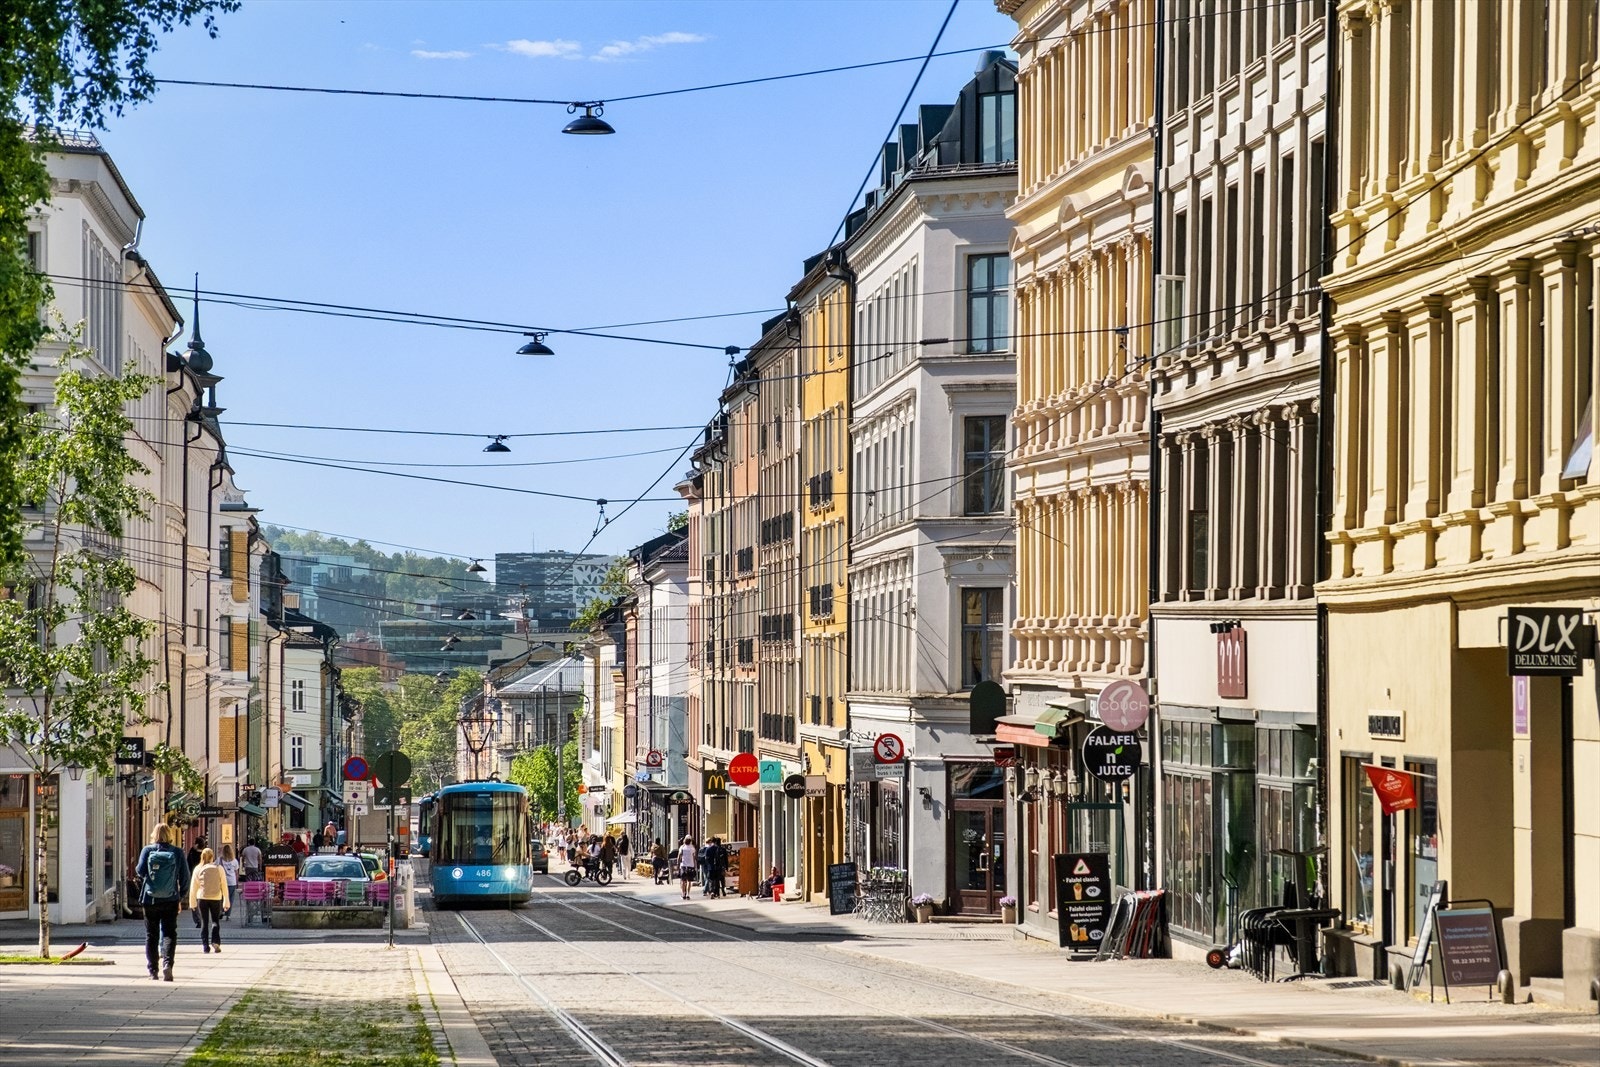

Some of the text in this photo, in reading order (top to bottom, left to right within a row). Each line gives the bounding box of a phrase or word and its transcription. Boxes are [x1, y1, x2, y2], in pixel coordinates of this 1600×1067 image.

[1516, 614, 1579, 653] DLX
[1515, 654, 1577, 666] DELUXE MUSIC
[1088, 735, 1138, 746] FALAFEL
[1097, 765, 1131, 775] JUICE
[476, 869, 491, 877] 486
